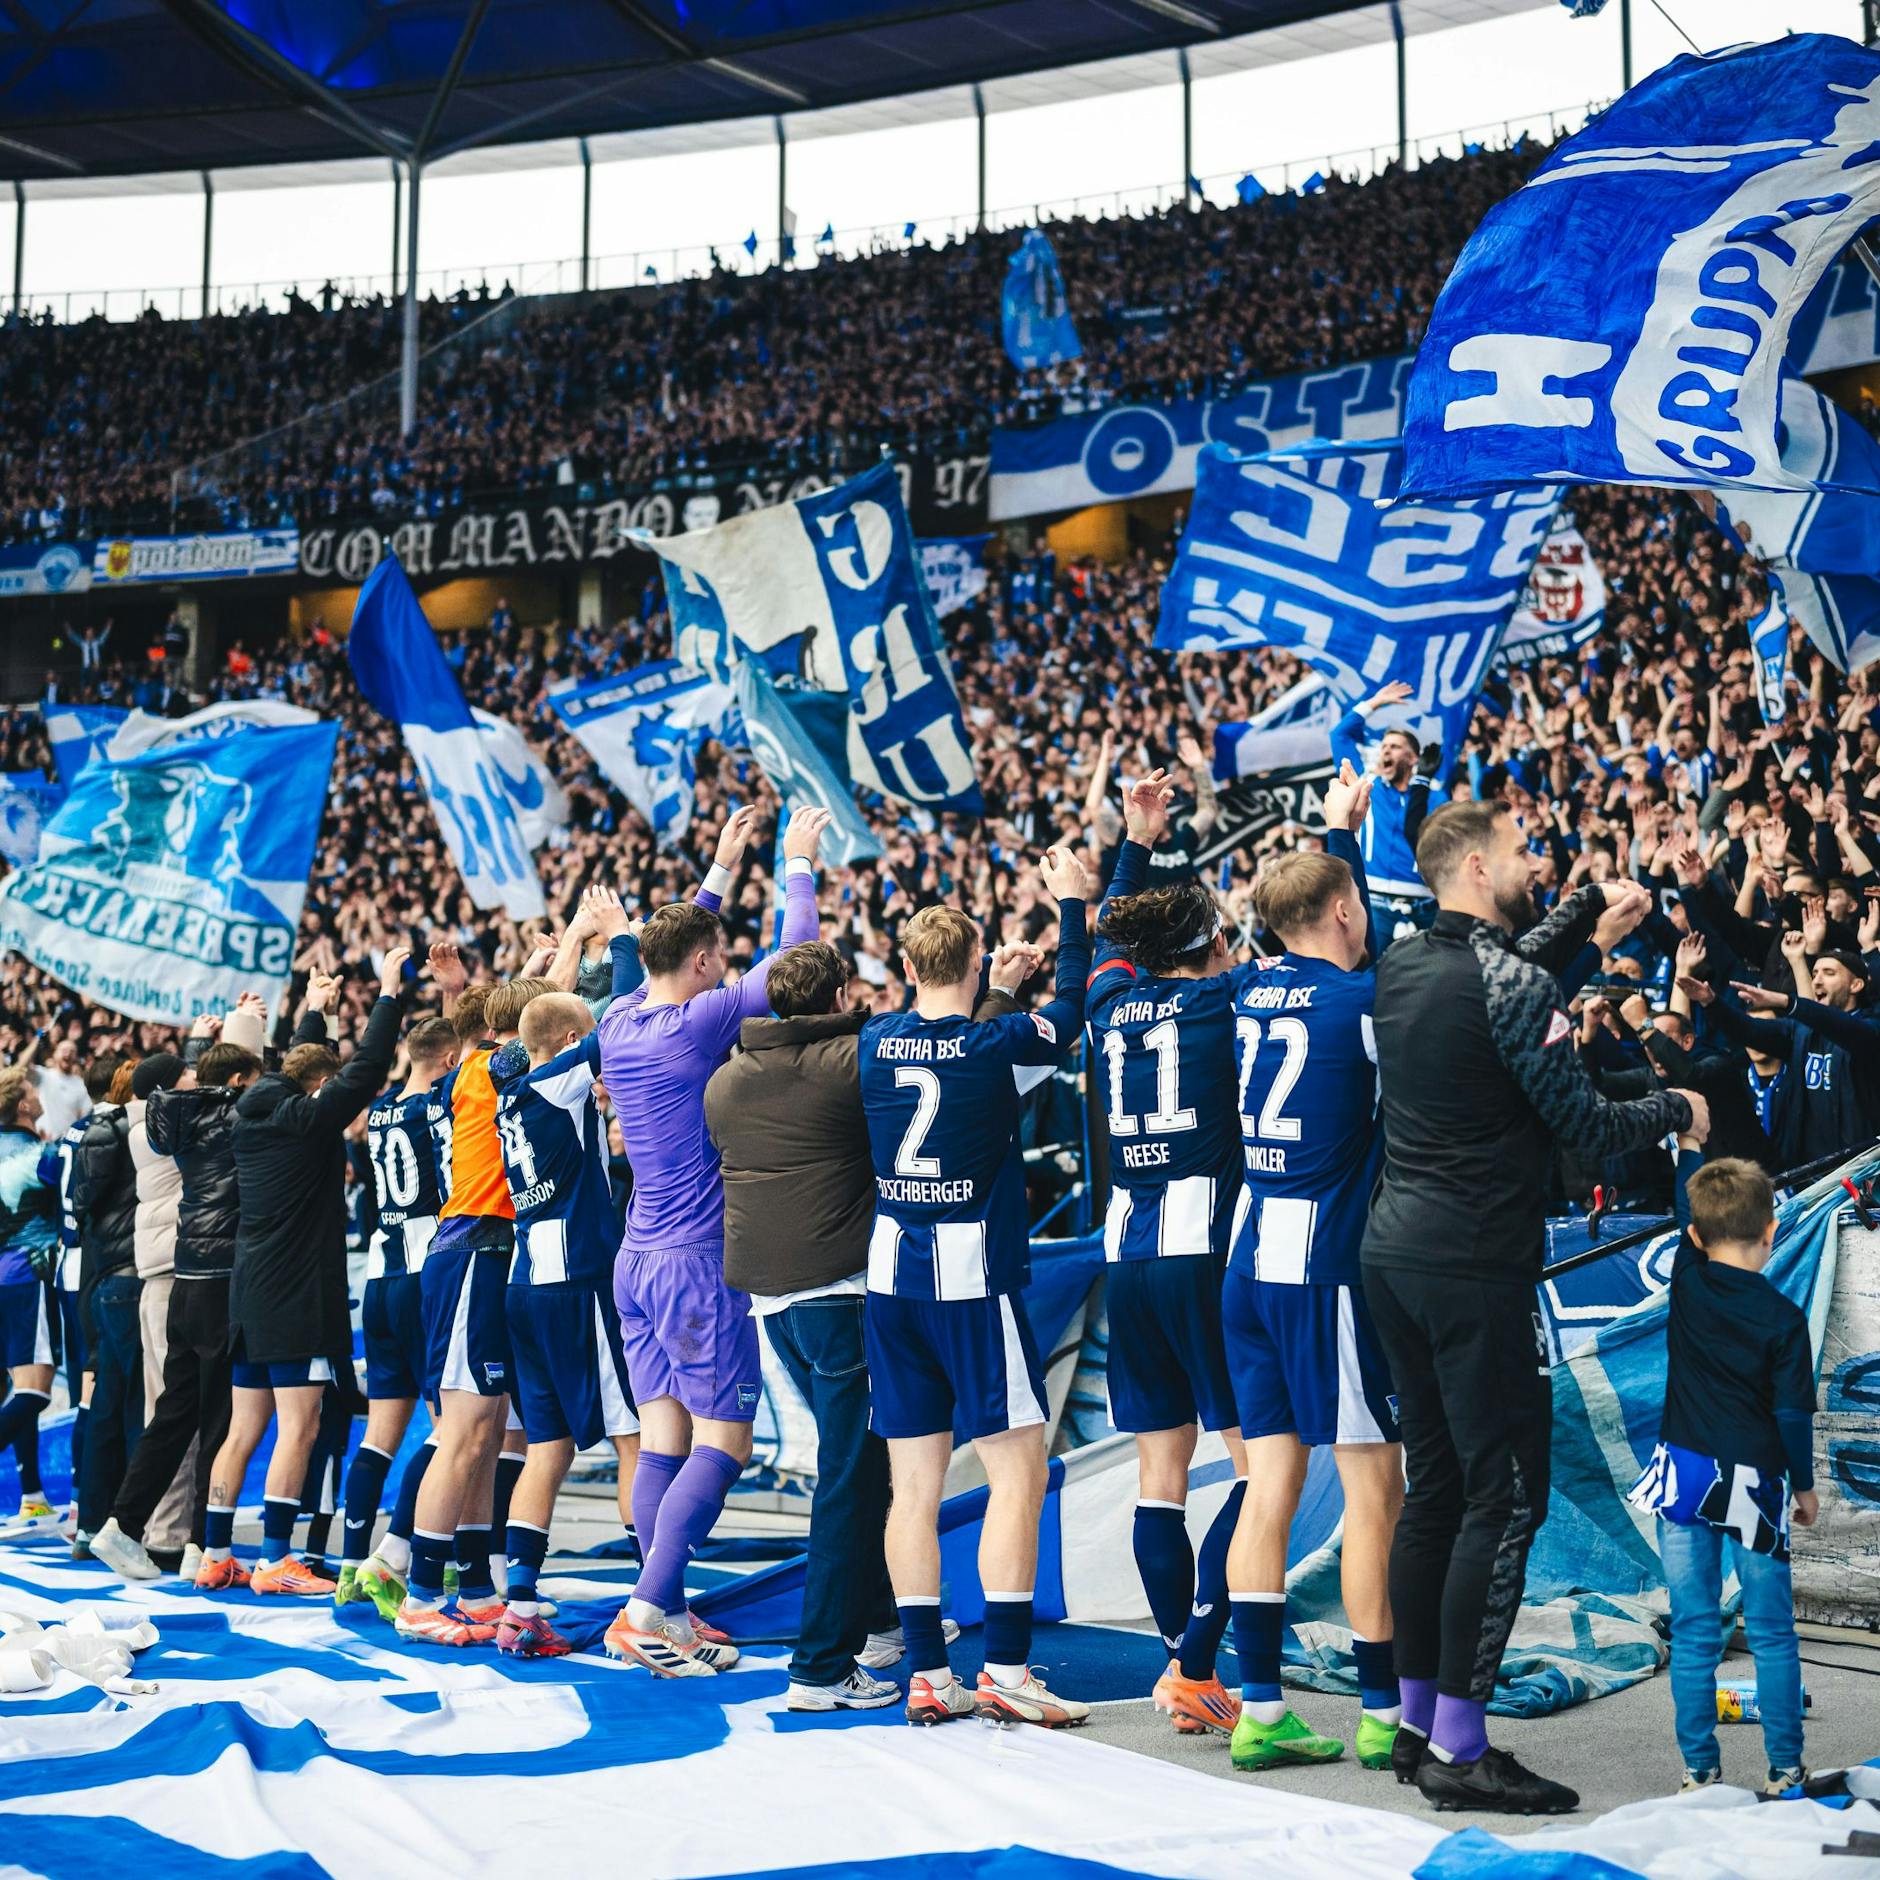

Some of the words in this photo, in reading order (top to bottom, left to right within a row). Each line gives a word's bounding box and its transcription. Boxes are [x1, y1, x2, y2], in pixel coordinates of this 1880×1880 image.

[877, 1037, 932, 1061] HERTHA
[936, 1036, 966, 1060] BSC
[1103, 1019, 1197, 1137] 11
[1236, 1017, 1309, 1141] 22
[895, 1066, 941, 1178] 2
[1122, 1143, 1171, 1168] REESE
